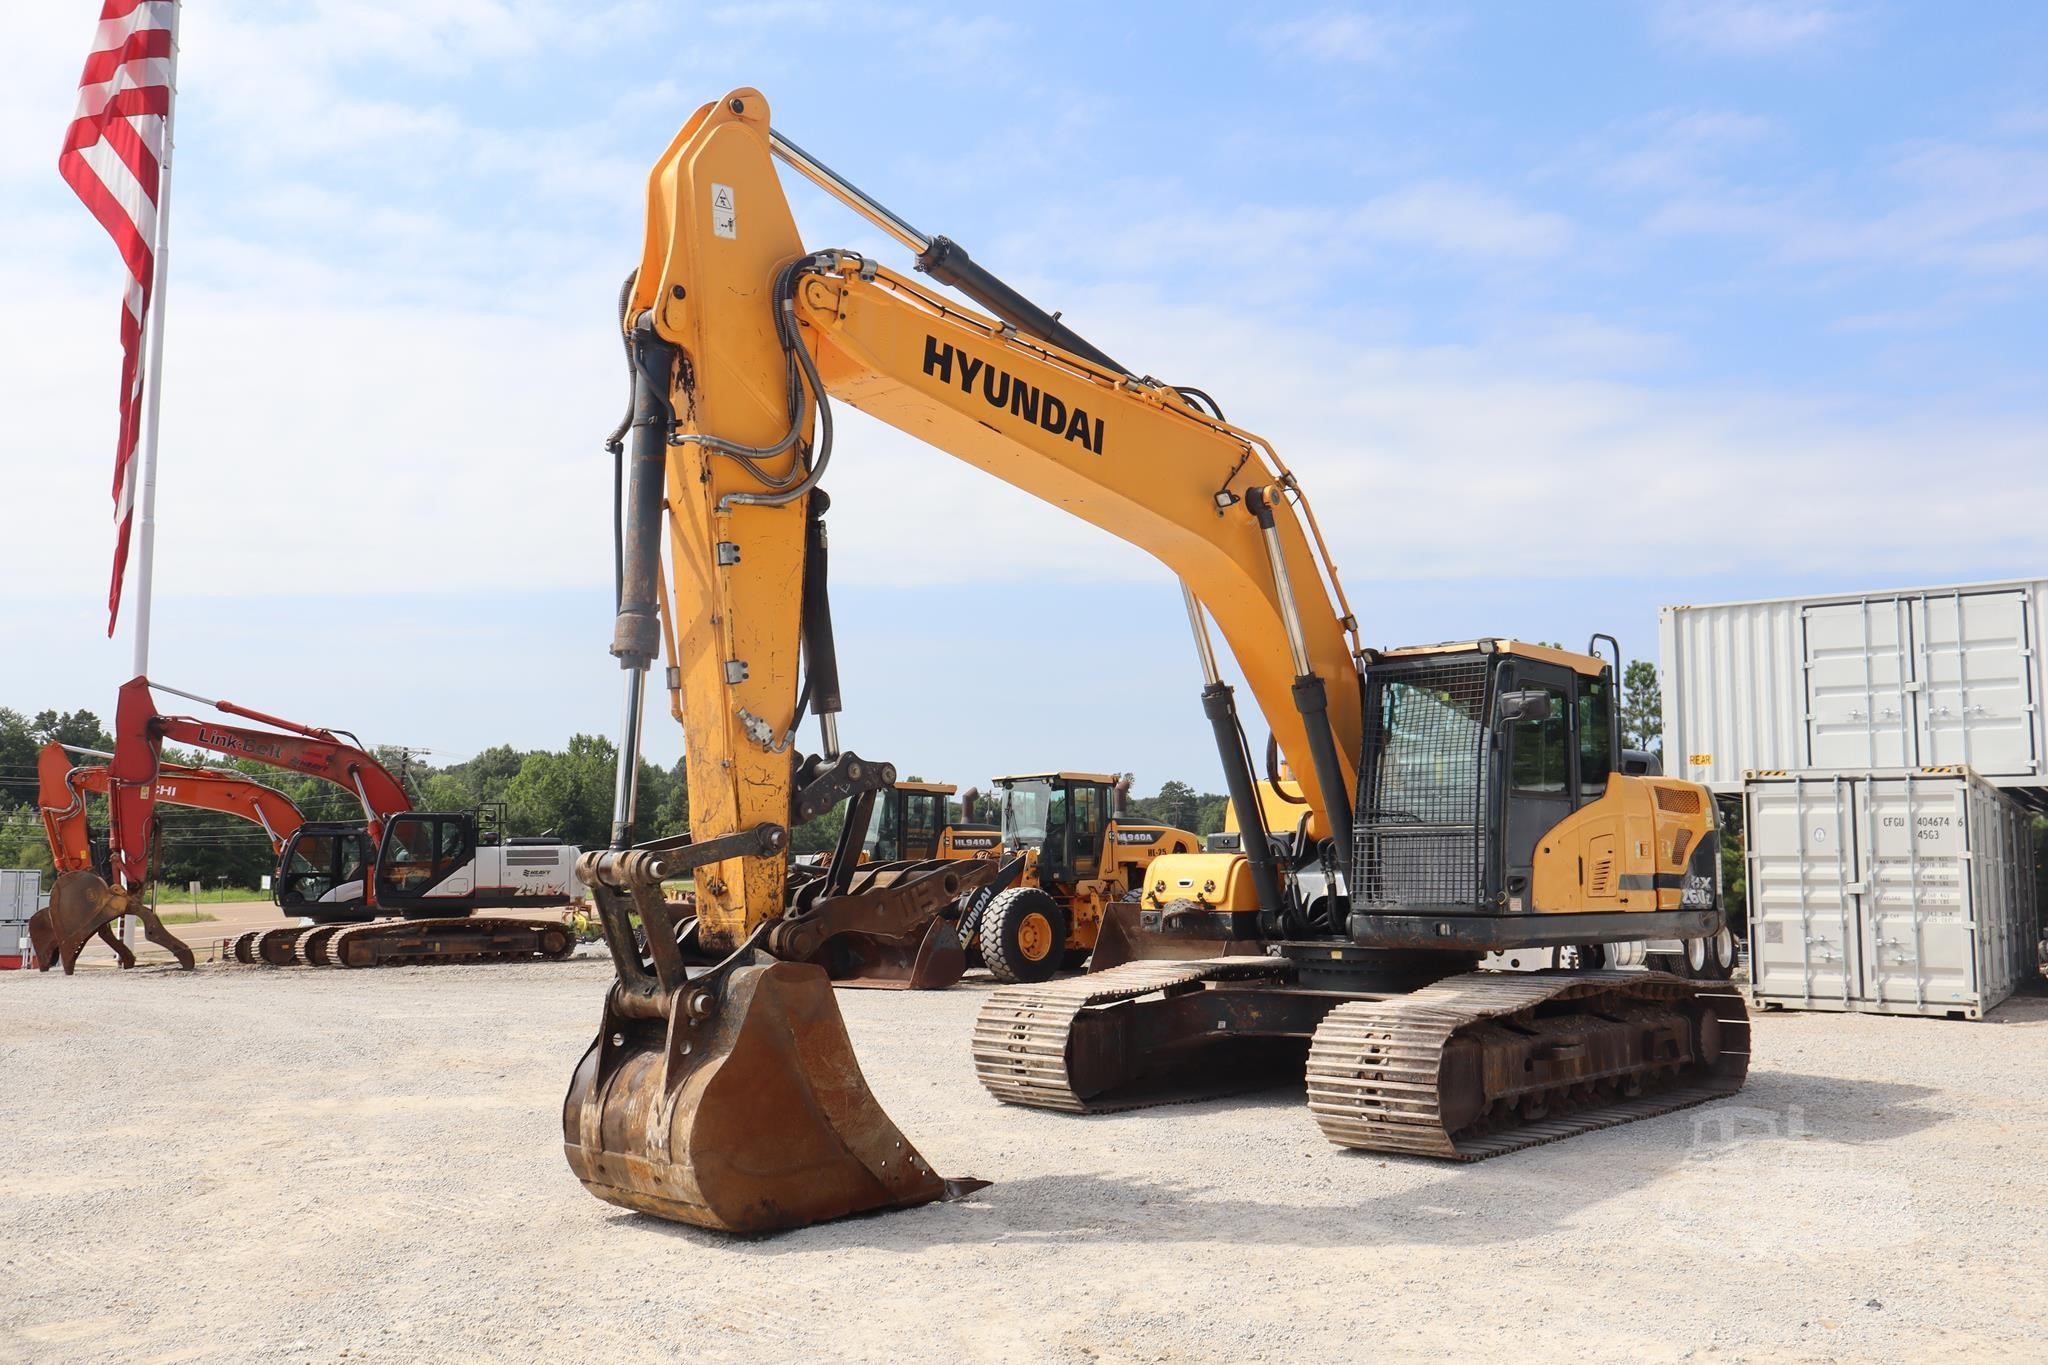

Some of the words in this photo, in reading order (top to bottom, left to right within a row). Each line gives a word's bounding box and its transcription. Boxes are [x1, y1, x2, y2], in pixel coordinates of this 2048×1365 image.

[923, 334, 1105, 456] HYUNDAI
[1689, 754, 1712, 766] REAR
[1883, 816, 1905, 828] CFGU
[1916, 816, 1950, 828] 404674
[1917, 829, 1940, 840] 45G3
[954, 838, 993, 848] HL940A
